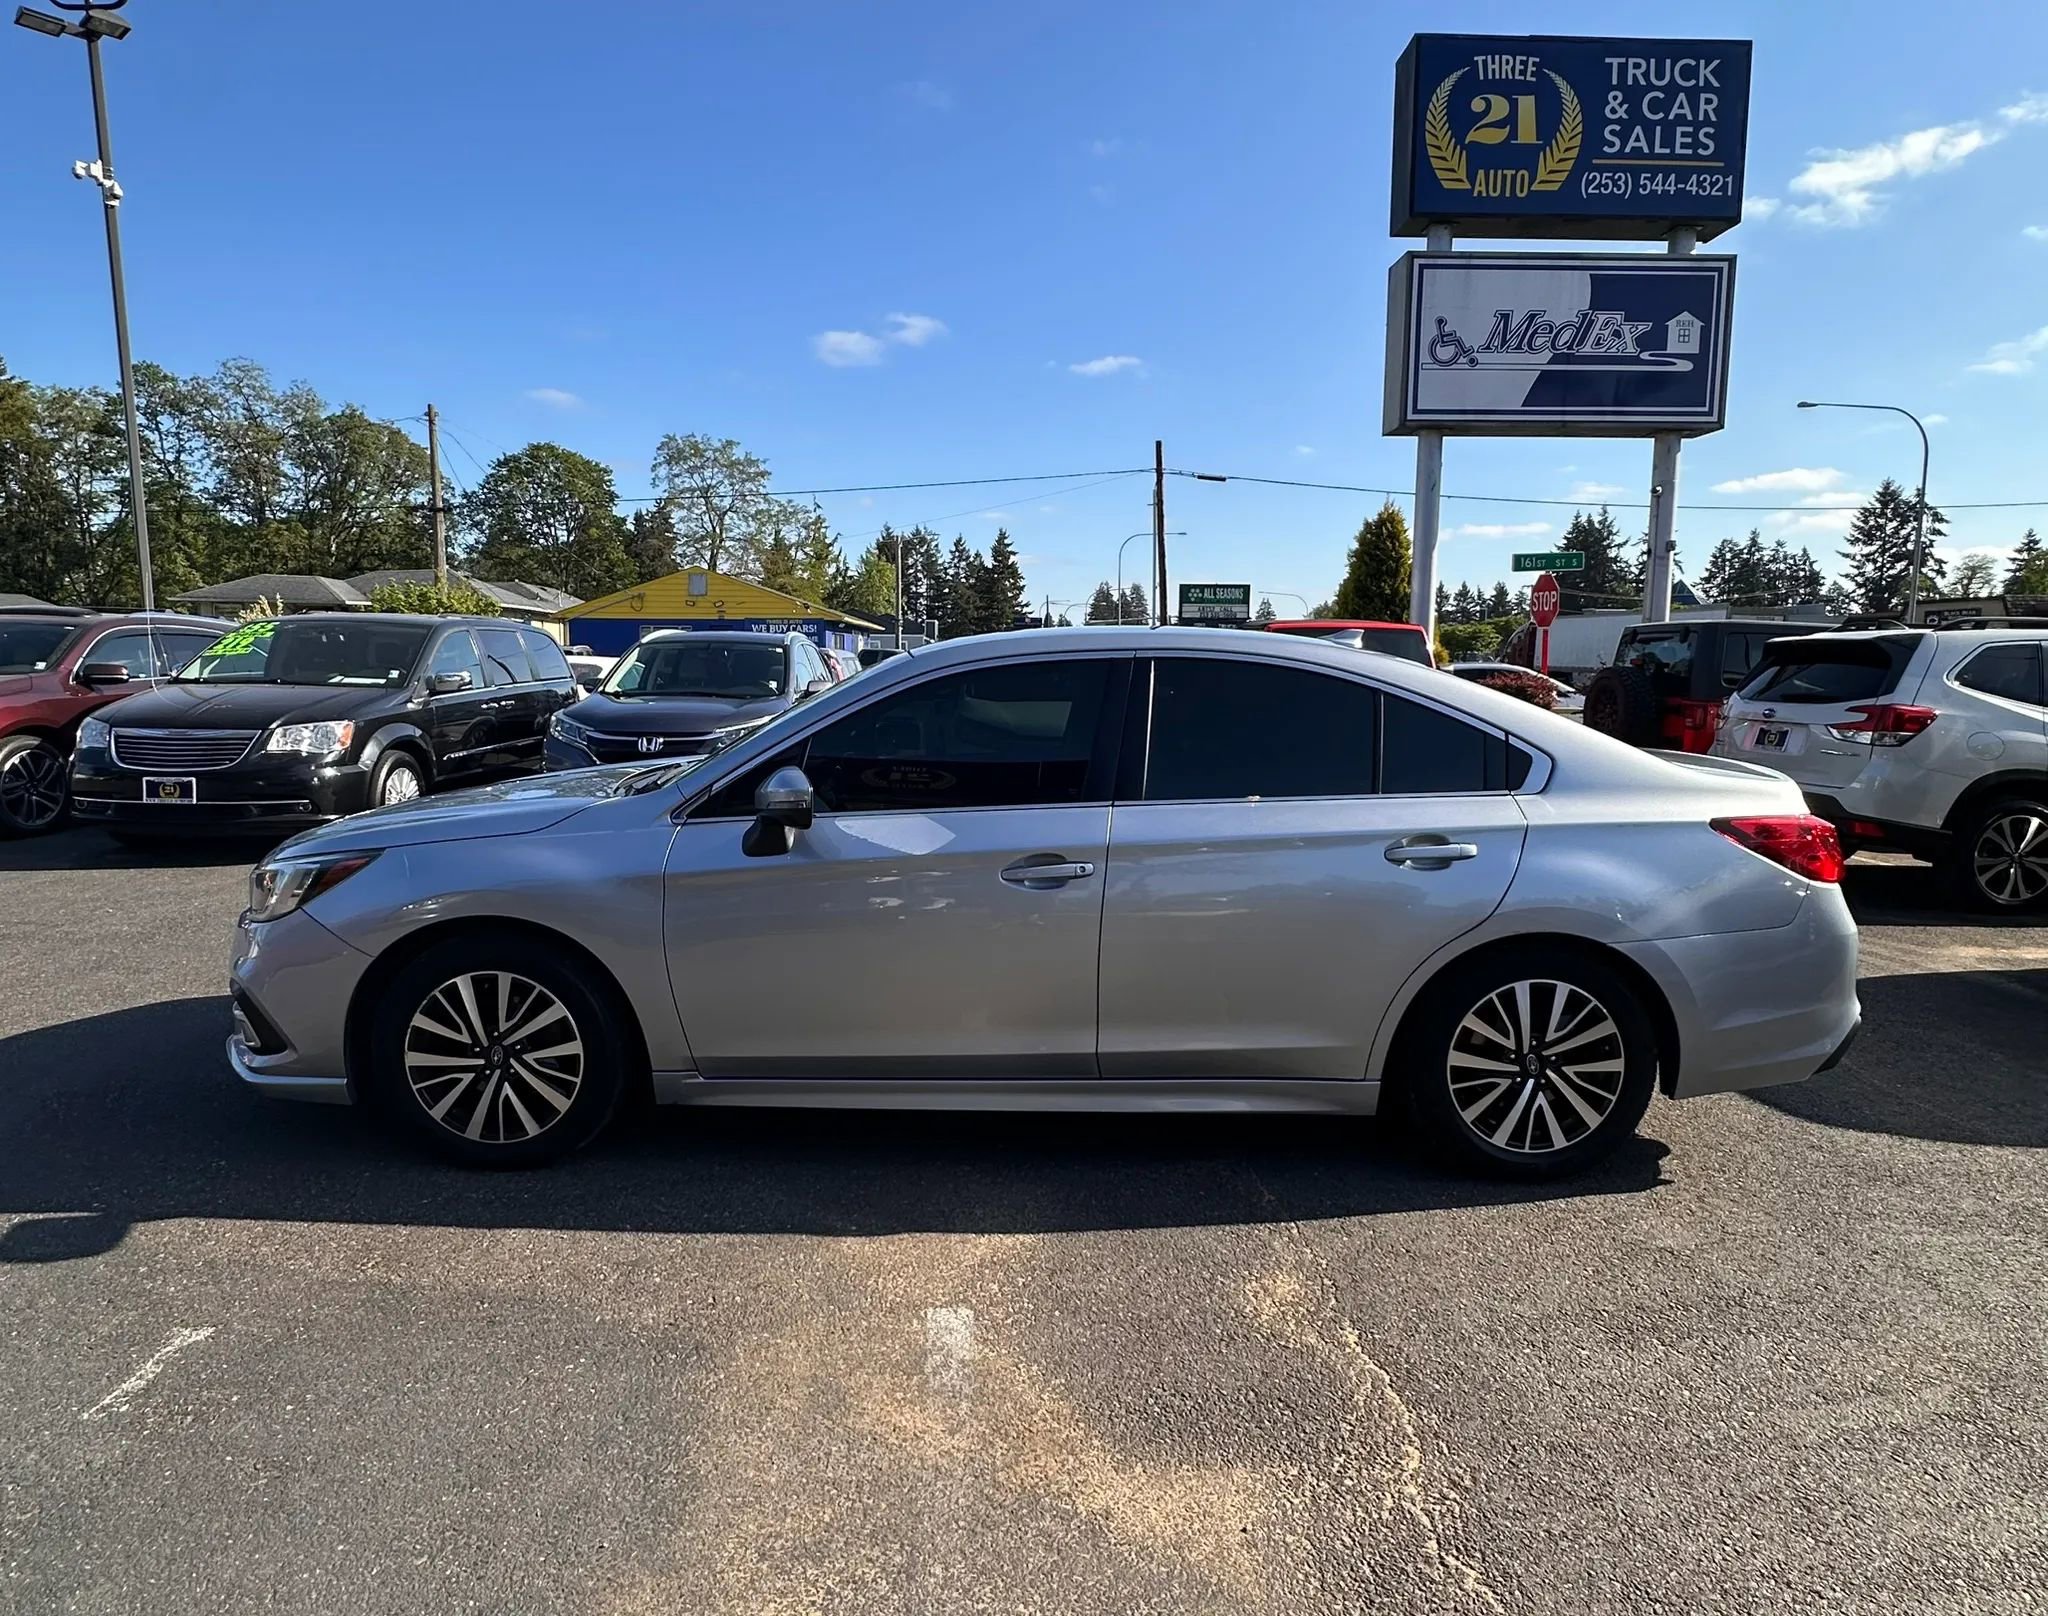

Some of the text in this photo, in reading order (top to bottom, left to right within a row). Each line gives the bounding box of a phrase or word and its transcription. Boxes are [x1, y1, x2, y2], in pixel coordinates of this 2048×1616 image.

[1473, 54, 1540, 82] THREE
[1604, 57, 1721, 88] TRUCK
[1465, 93, 1543, 145] 21
[1604, 90, 1719, 122] & CAR
[1602, 125, 1715, 156] SALES
[1473, 168, 1530, 198] AUTO
[1581, 171, 1734, 199] (253) 544-4321
[1478, 309, 1652, 356] MedEx
[1520, 557, 1546, 568] 161ST
[1555, 559, 1566, 567] ST
[1203, 588, 1243, 599] ALL SEASONS
[1532, 590, 1558, 612] STOP
[751, 624, 817, 633] WE BUY CARS!
